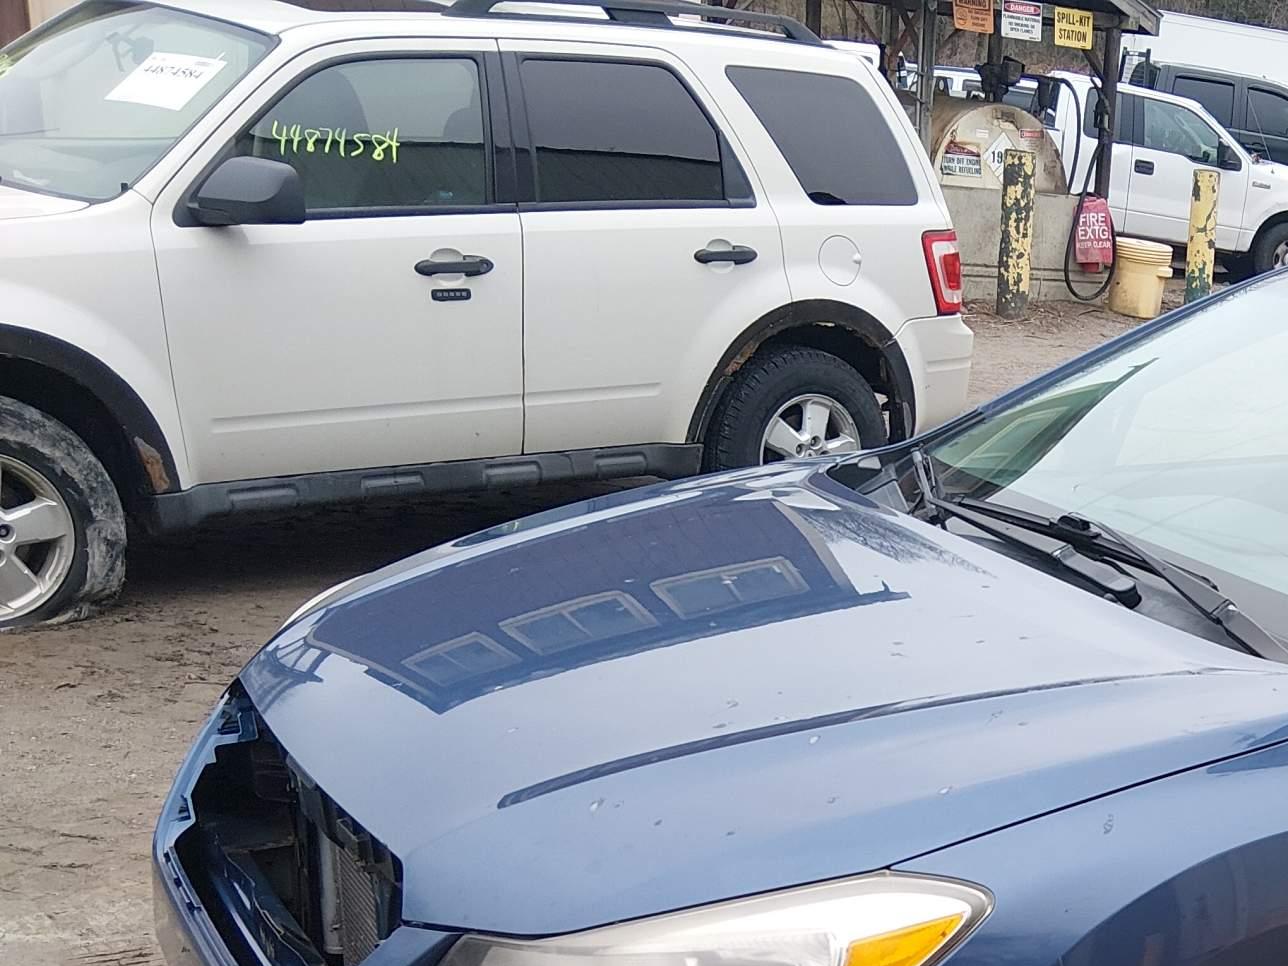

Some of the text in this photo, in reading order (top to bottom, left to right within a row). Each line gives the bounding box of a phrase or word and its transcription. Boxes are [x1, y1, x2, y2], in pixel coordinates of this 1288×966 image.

[1010, 3, 1034, 13] DANGER
[1056, 12, 1091, 27] SPILL-KIT
[1058, 28, 1087, 43] STATION
[272, 120, 400, 163] 44874584
[1080, 213, 1105, 226] FIRE
[1093, 241, 1111, 249] CLEAR
